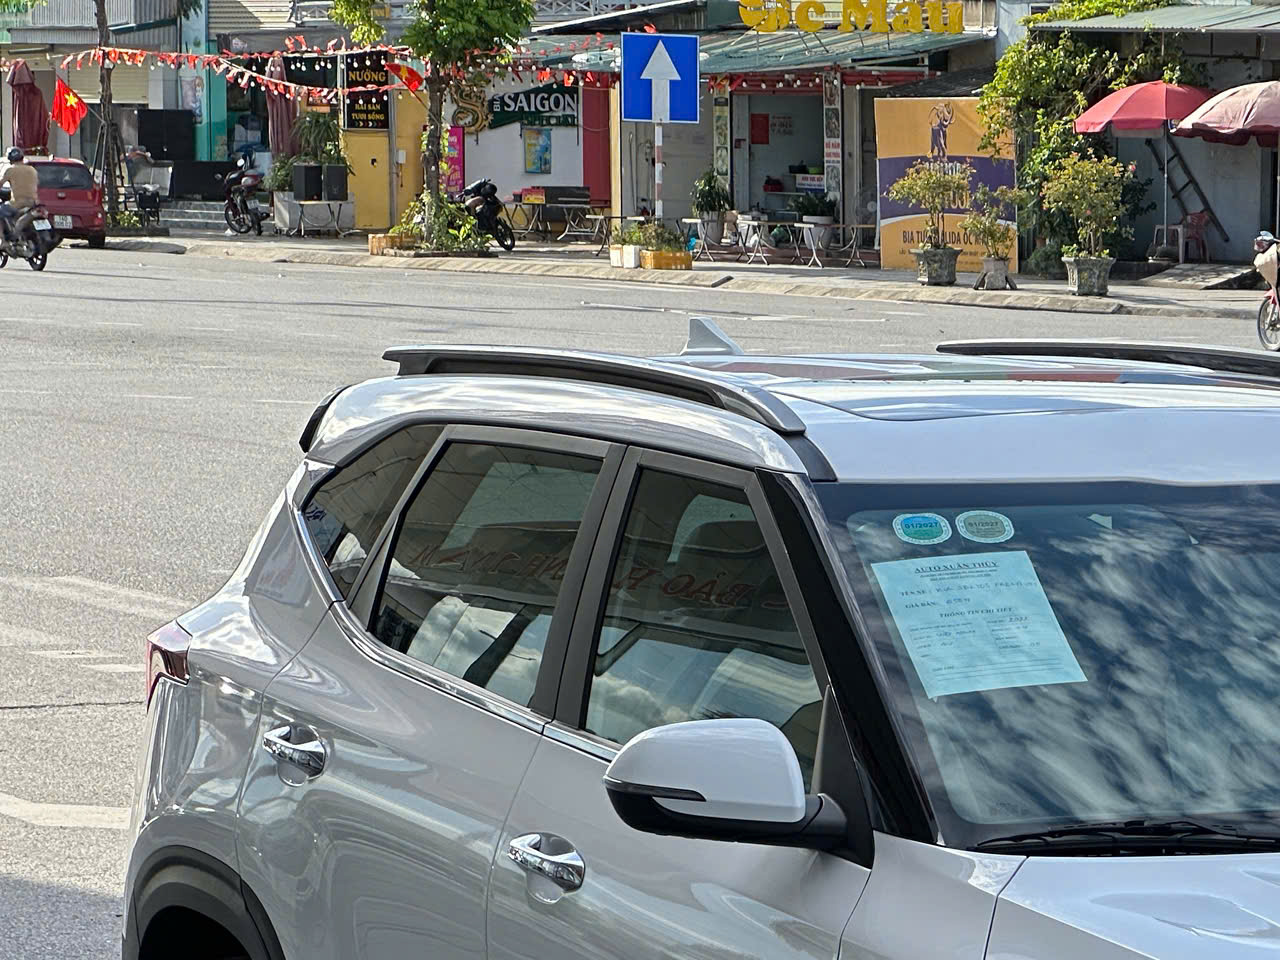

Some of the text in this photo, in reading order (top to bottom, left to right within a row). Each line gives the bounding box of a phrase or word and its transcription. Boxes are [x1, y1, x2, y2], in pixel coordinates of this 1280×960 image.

[348, 69, 386, 82] NƯỚNG
[503, 92, 577, 112] SAIGON
[902, 231, 914, 244] BIA
